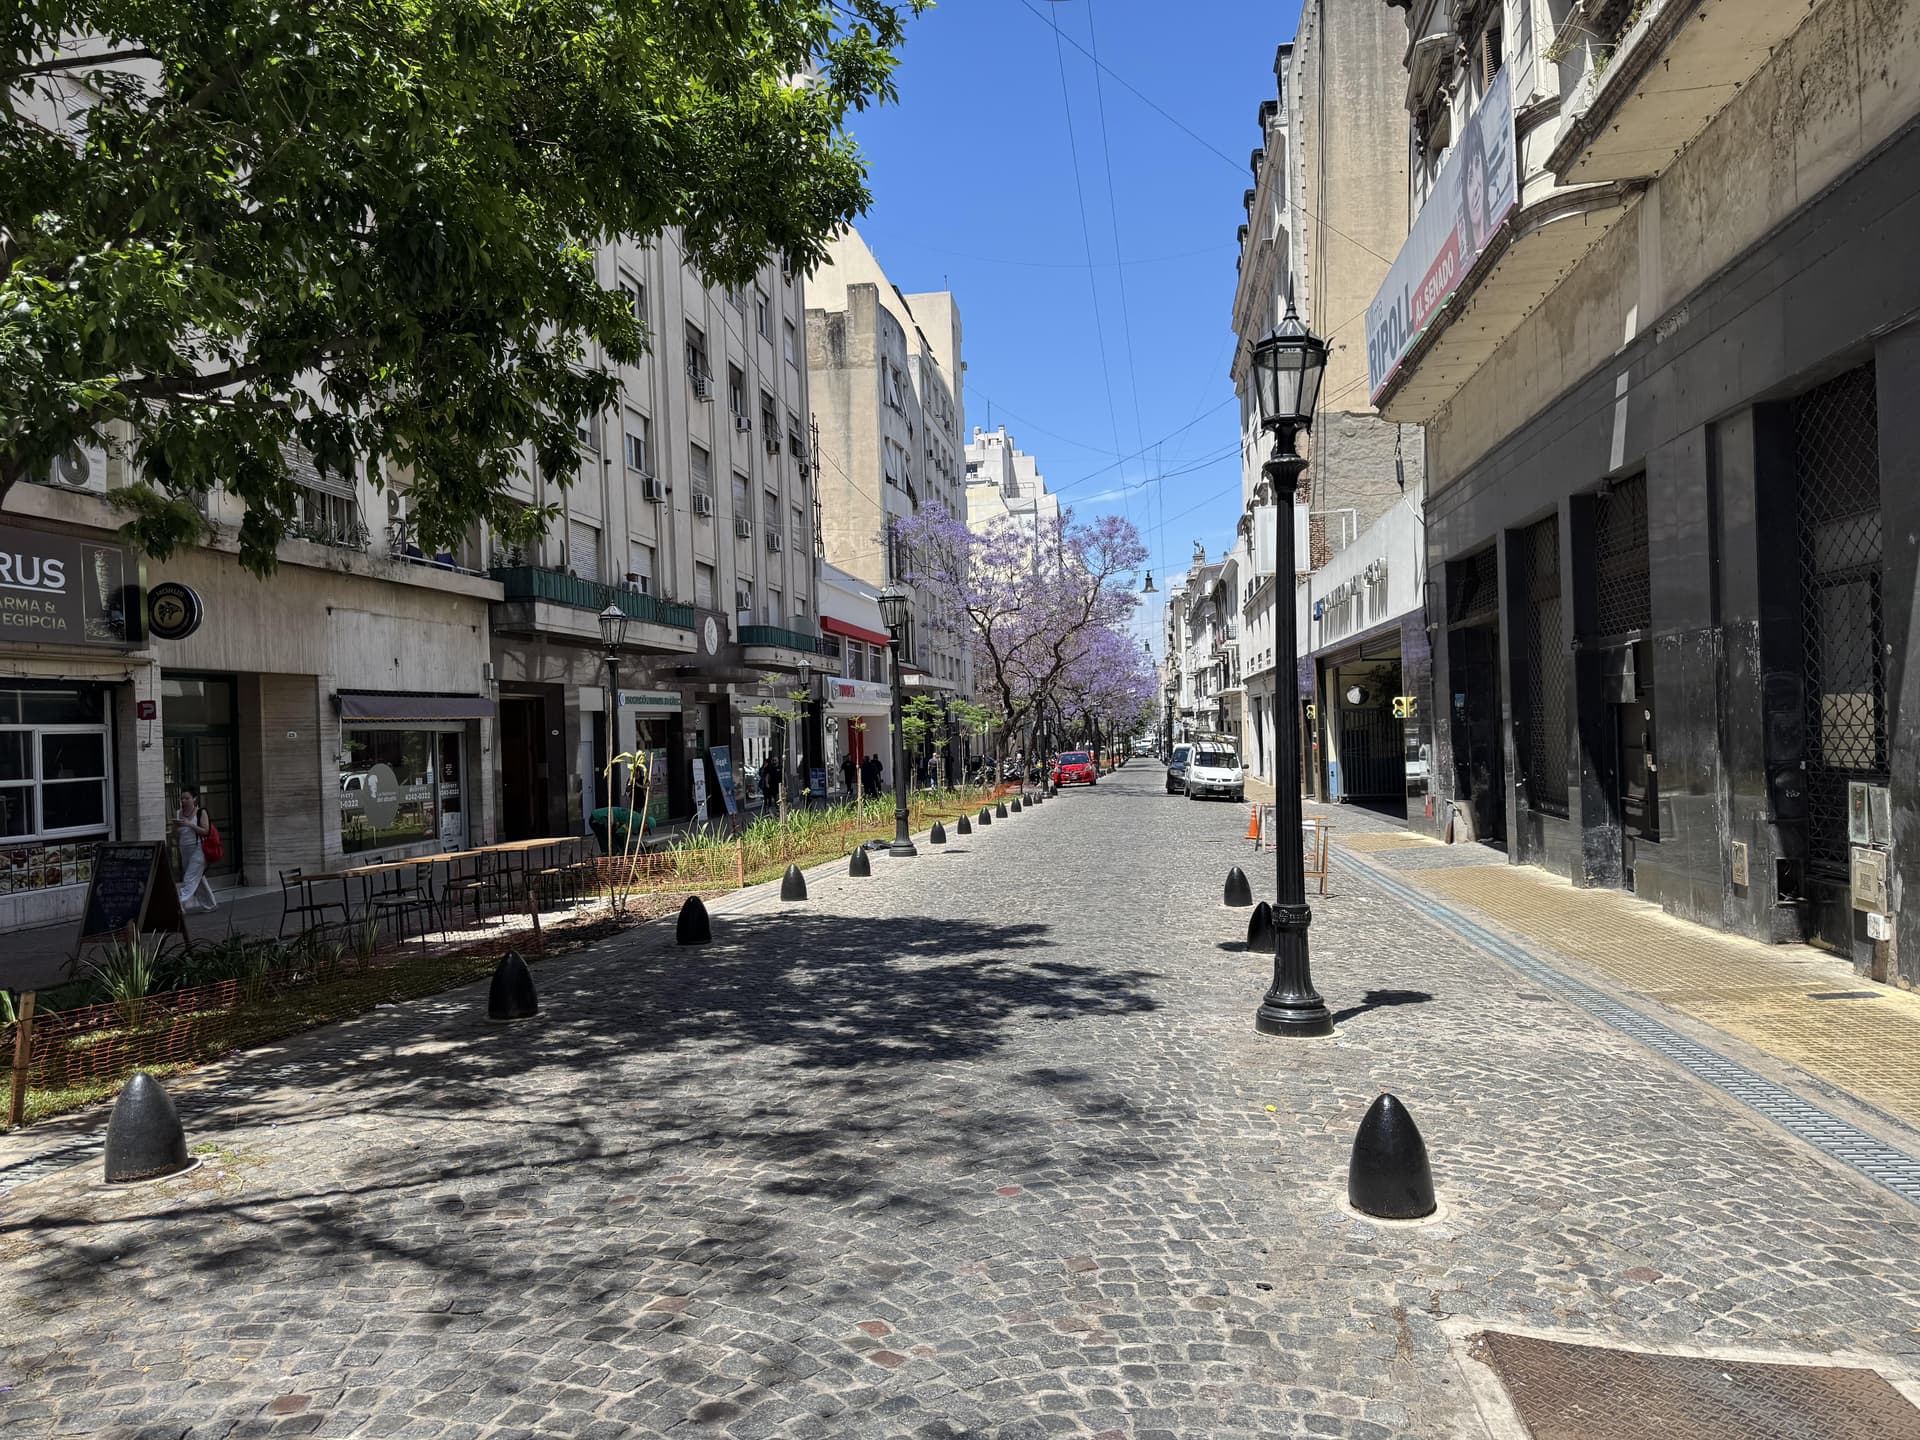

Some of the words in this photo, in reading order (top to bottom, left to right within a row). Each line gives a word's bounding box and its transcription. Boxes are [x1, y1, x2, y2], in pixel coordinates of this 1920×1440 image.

[1415, 296, 1424, 325] AL
[1424, 251, 1454, 309] SENADO
[1368, 282, 1414, 391] RIPOLL
[2, 612, 68, 631] EGIPCIA
[45, 601, 56, 614] &
